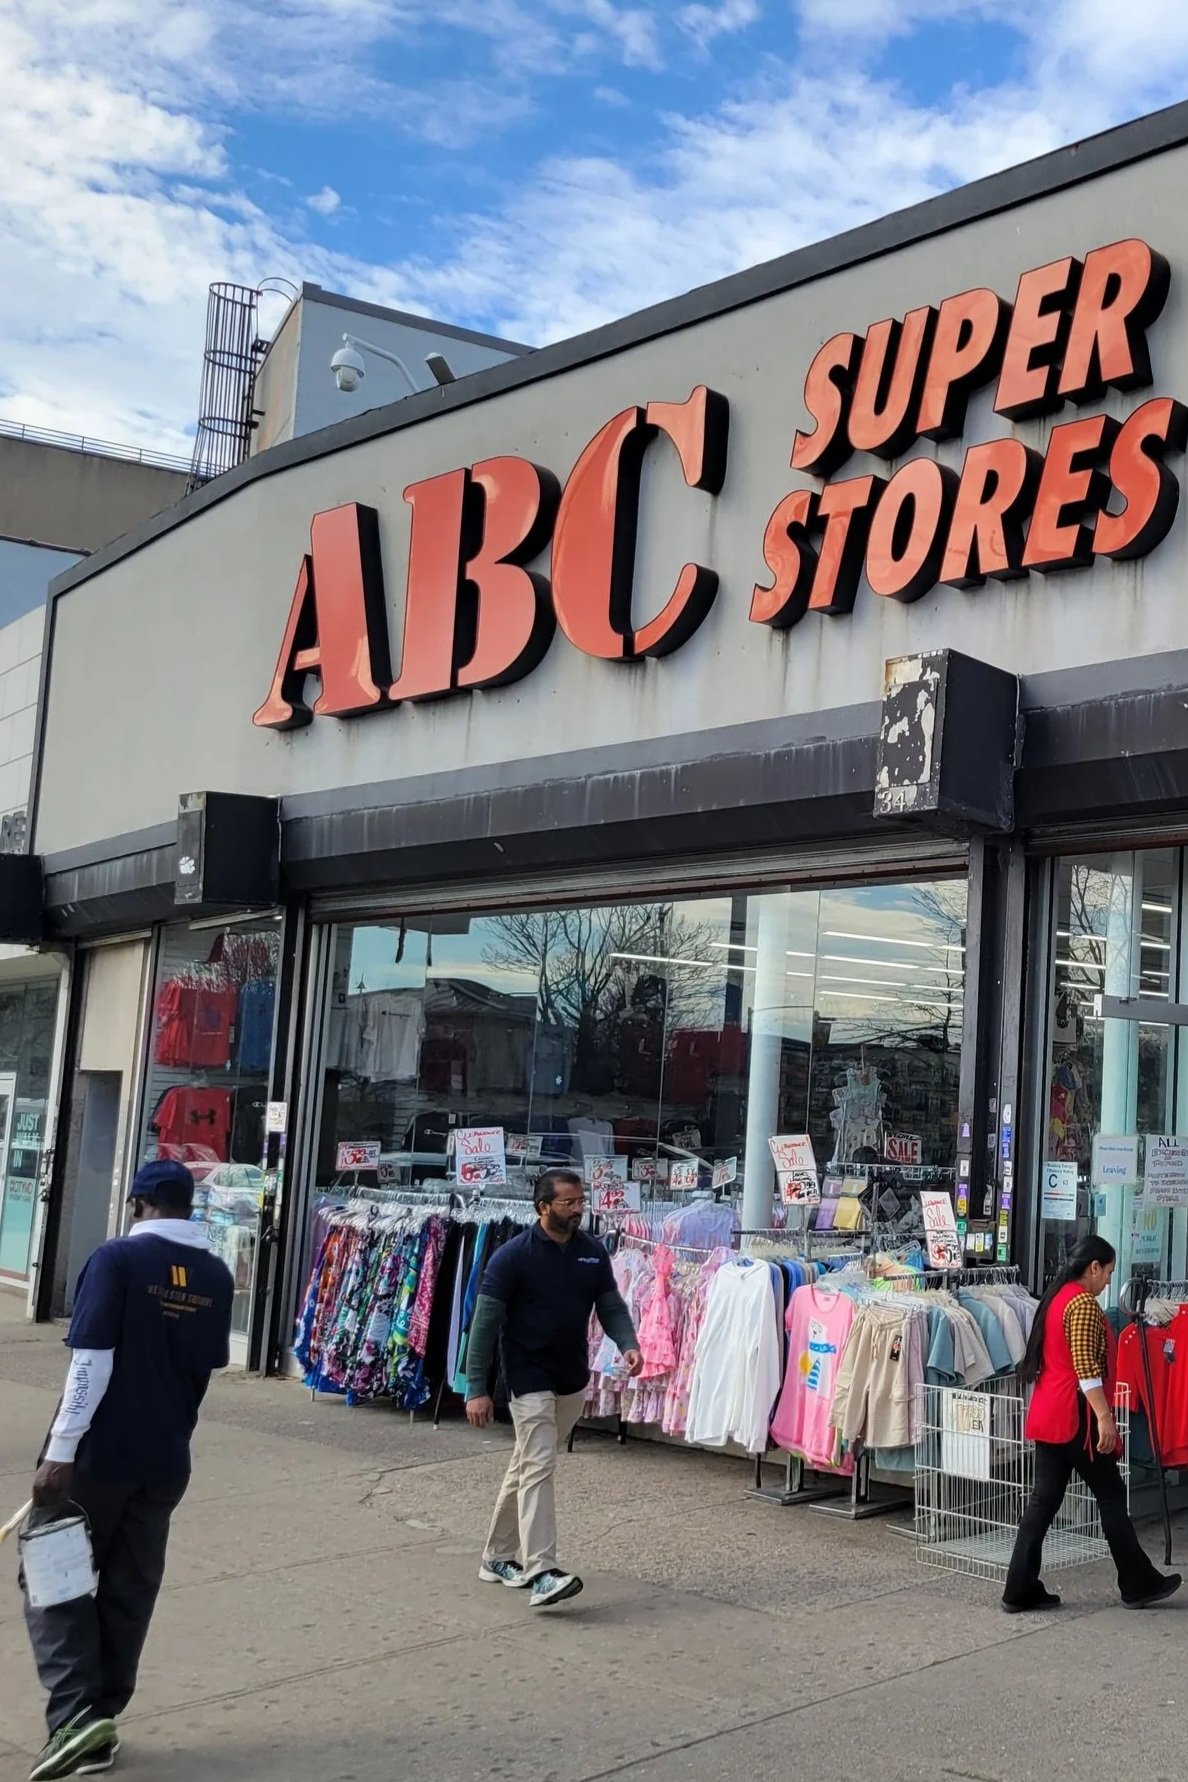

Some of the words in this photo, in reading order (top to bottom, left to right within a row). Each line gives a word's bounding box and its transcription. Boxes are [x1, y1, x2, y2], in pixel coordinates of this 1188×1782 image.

[791, 237, 1171, 477] SUPER
[253, 384, 729, 731] ABC
[17, 1113, 40, 1130] JUST
[461, 1138, 497, 1156] Sale
[1158, 1136, 1180, 1148] ALL
[887, 1138, 919, 1164] SALE
[1102, 1165, 1127, 1174] Leaving
[1048, 1173, 1058, 1188] C
